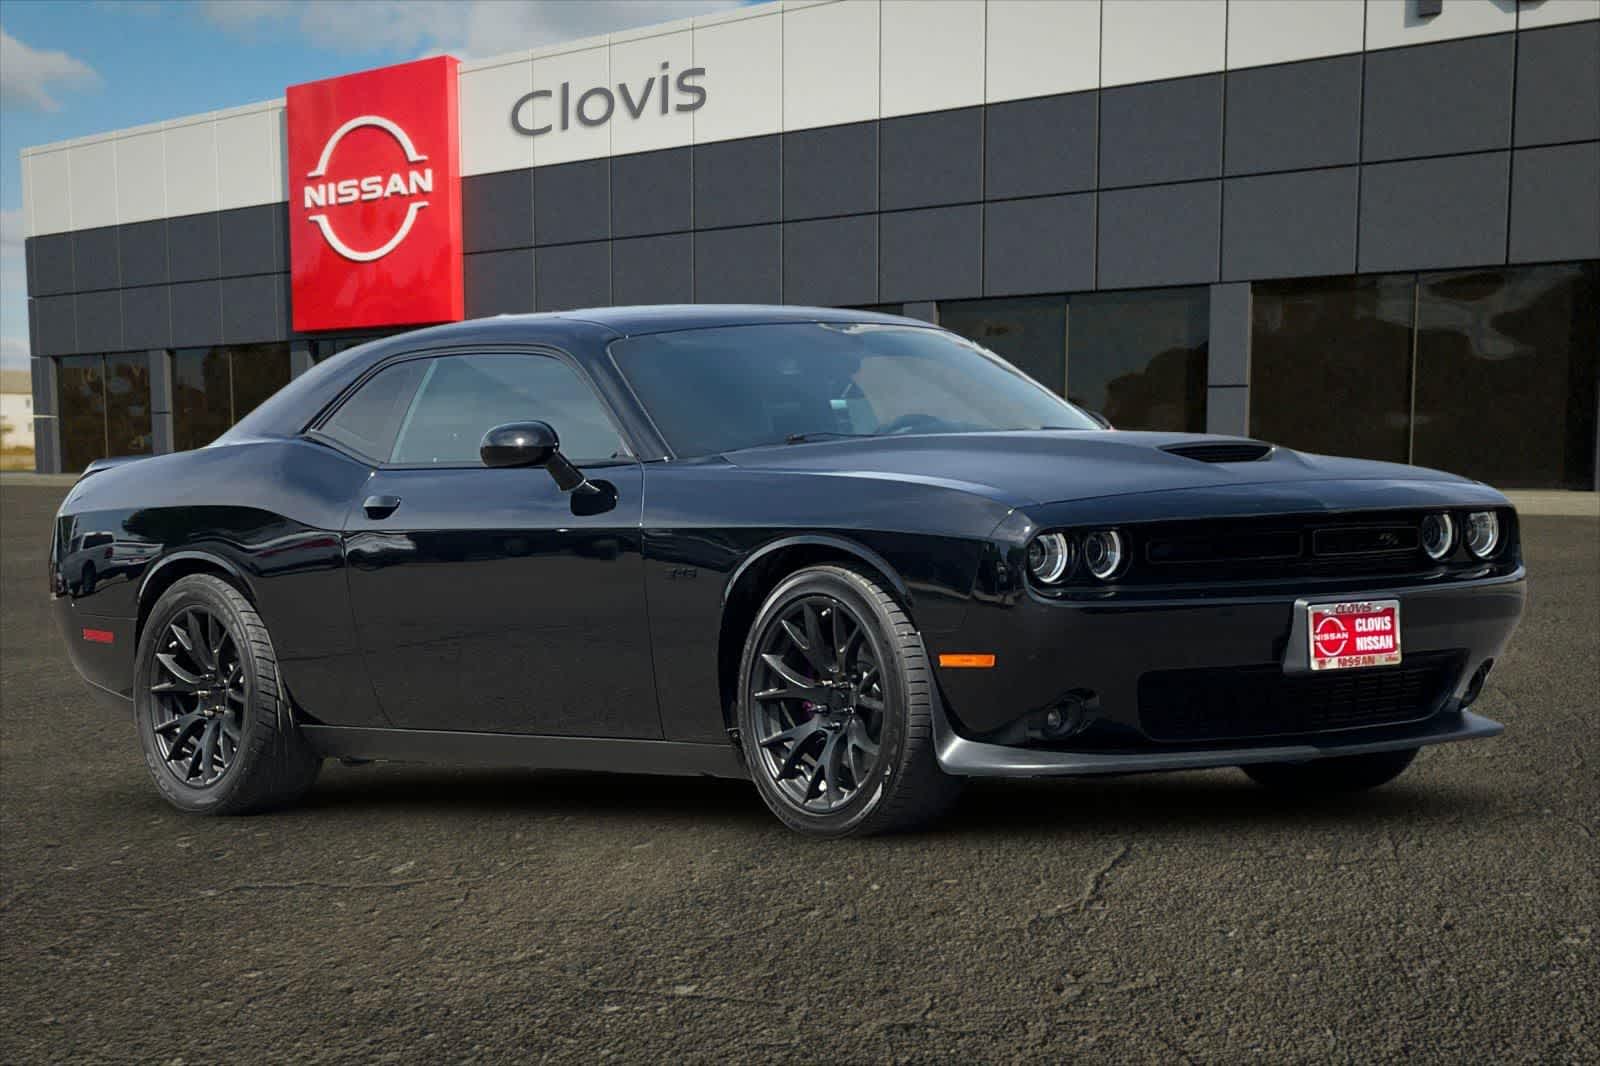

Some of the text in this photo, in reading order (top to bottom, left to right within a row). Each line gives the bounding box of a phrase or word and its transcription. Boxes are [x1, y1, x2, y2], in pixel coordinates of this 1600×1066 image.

[511, 62, 707, 136] Clovis
[304, 168, 433, 208] NISSAN
[1335, 602, 1372, 614] CLOVIS
[1355, 616, 1391, 632] CLOVIS
[1314, 631, 1349, 641] NISSAN
[1355, 634, 1394, 651] NISSAN
[1337, 655, 1376, 668] NISSAN
